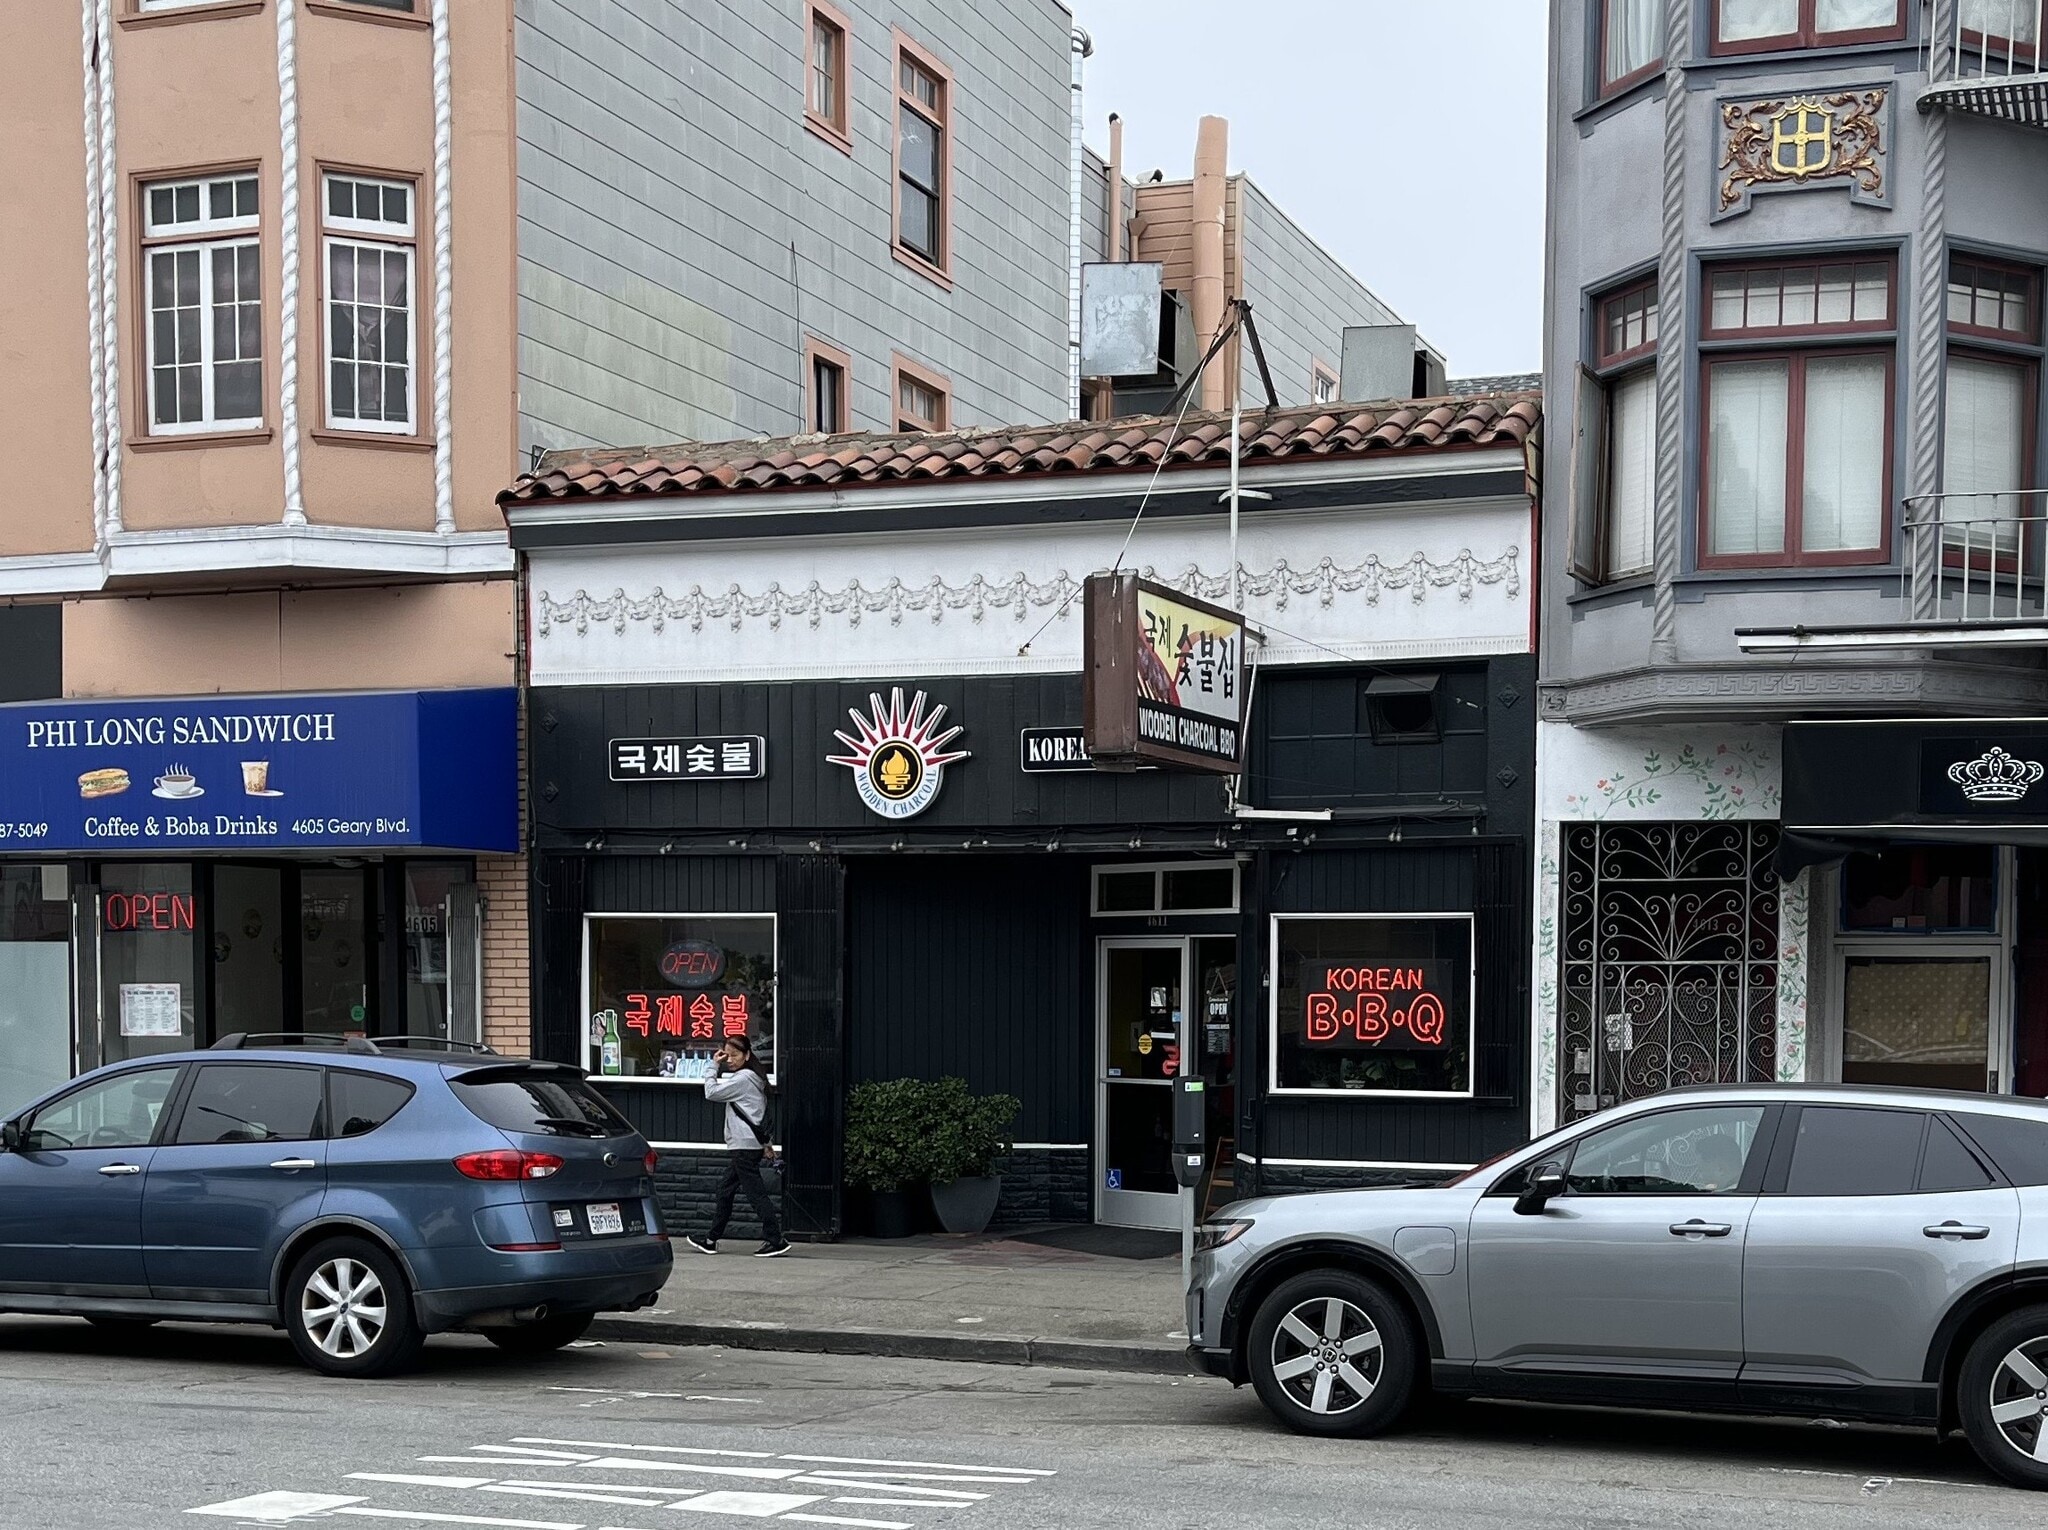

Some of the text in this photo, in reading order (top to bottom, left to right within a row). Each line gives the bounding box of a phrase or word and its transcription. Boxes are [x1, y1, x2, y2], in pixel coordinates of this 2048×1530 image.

[27, 713, 335, 748] PHI LONG SANDWICH
[1139, 707, 1236, 760] WOODEN CHARCOAL BBQ
[1028, 737, 1092, 761] KOREA
[857, 769, 937, 815] WOODEN CHARCOAL
[84, 815, 278, 837] Coffee & Boba Drinks
[291, 817, 410, 836] 4605 Geary Blvd.
[107, 893, 194, 930] OPEN
[661, 952, 719, 974] OPEN
[1326, 968, 1423, 991] KOREAN
[1209, 1003, 1228, 1016] OPEN
